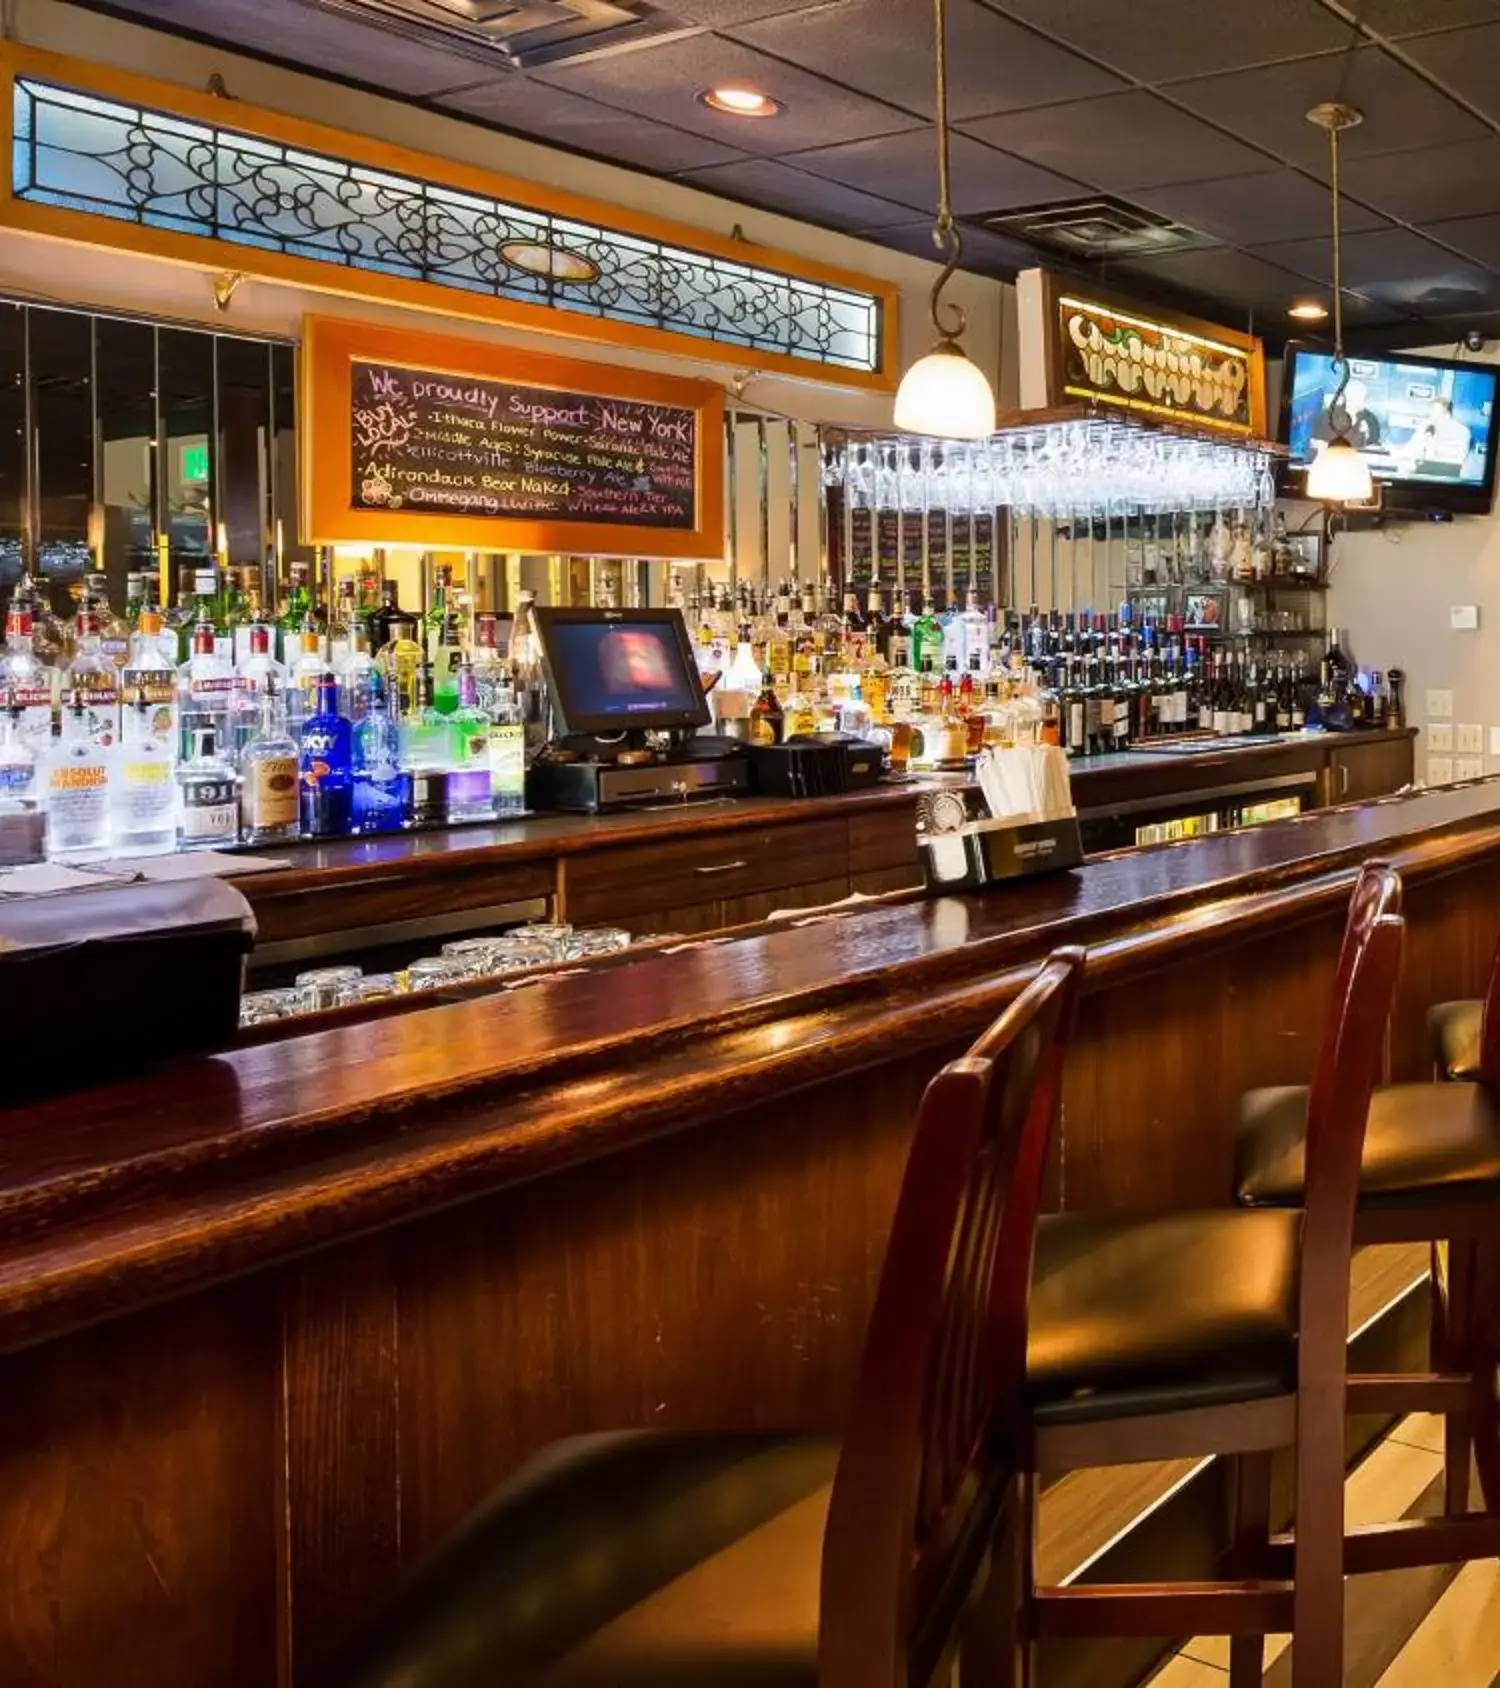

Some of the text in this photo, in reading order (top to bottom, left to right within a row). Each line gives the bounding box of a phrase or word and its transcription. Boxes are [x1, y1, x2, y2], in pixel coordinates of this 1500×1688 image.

[368, 369, 402, 396] We
[413, 382, 498, 418] proudly
[509, 395, 589, 426] Support
[602, 409, 642, 432] New
[355, 402, 394, 429] BUY
[522, 477, 569, 495] Naked
